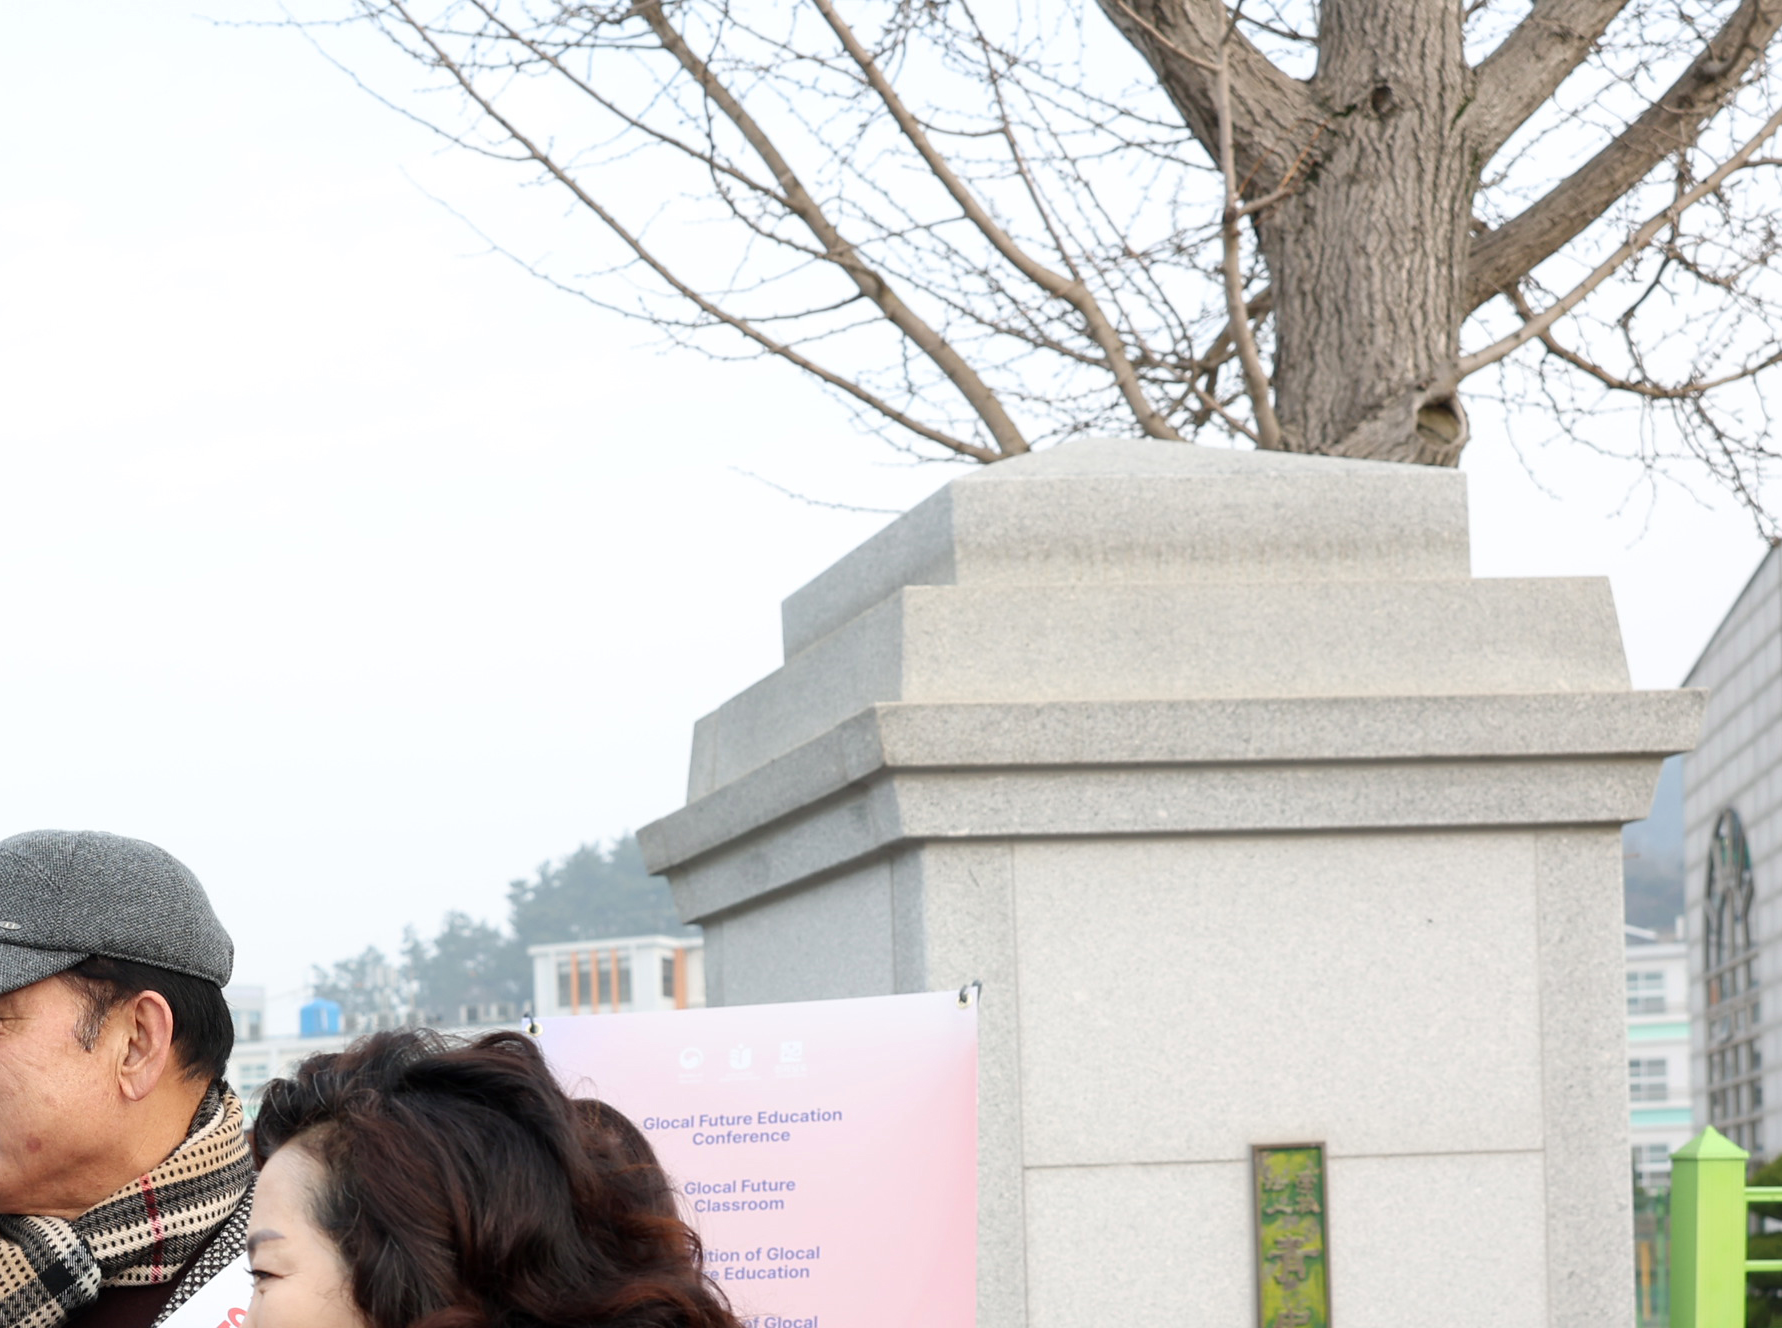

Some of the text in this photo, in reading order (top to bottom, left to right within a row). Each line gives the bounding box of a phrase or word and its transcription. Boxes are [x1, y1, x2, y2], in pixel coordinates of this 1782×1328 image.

[643, 1108, 843, 1130] Glocal Future Education
[692, 1130, 791, 1146] Conference
[684, 1179, 796, 1195] Glocal Future
[694, 1199, 785, 1213] Classroom
[702, 1246, 821, 1263] ition of Glocal
[724, 1265, 811, 1281] Education
